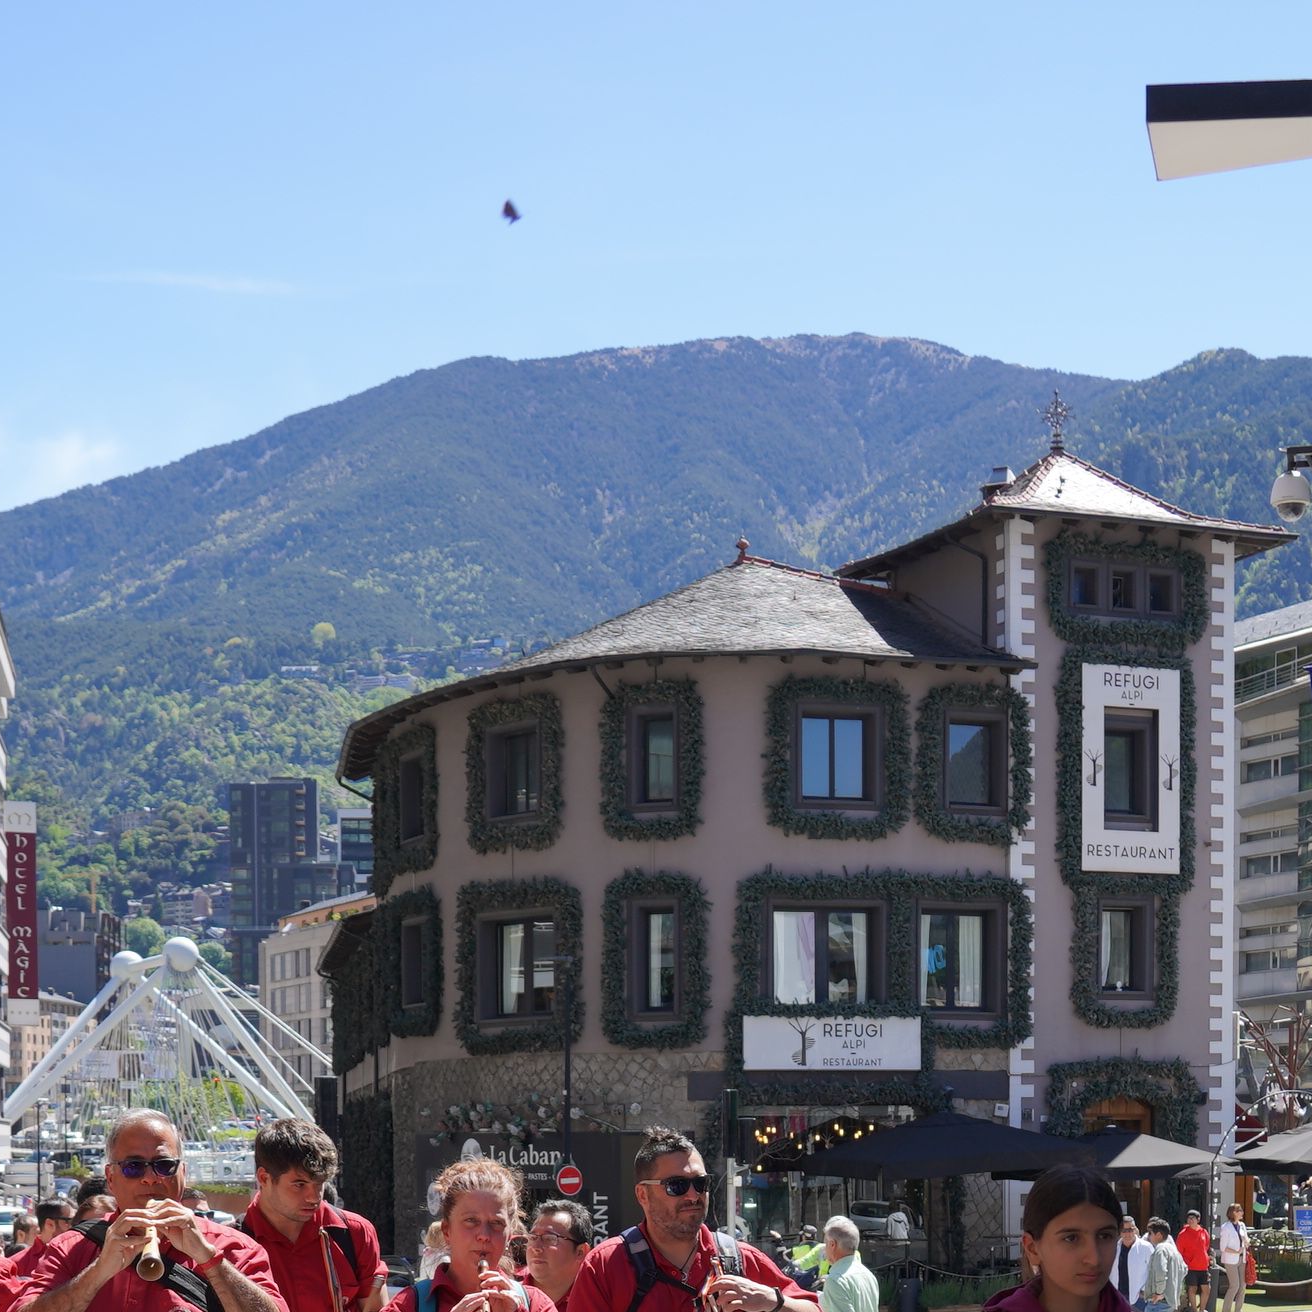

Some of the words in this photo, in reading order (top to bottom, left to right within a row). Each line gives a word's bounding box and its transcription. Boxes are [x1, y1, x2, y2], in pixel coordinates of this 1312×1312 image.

[1104, 672, 1160, 690] REFUGI
[1087, 844, 1176, 860] RESTAURANT
[823, 1023, 883, 1037] REFUGI
[823, 1058, 882, 1067] RESTAURANT
[489, 1144, 507, 1166] La
